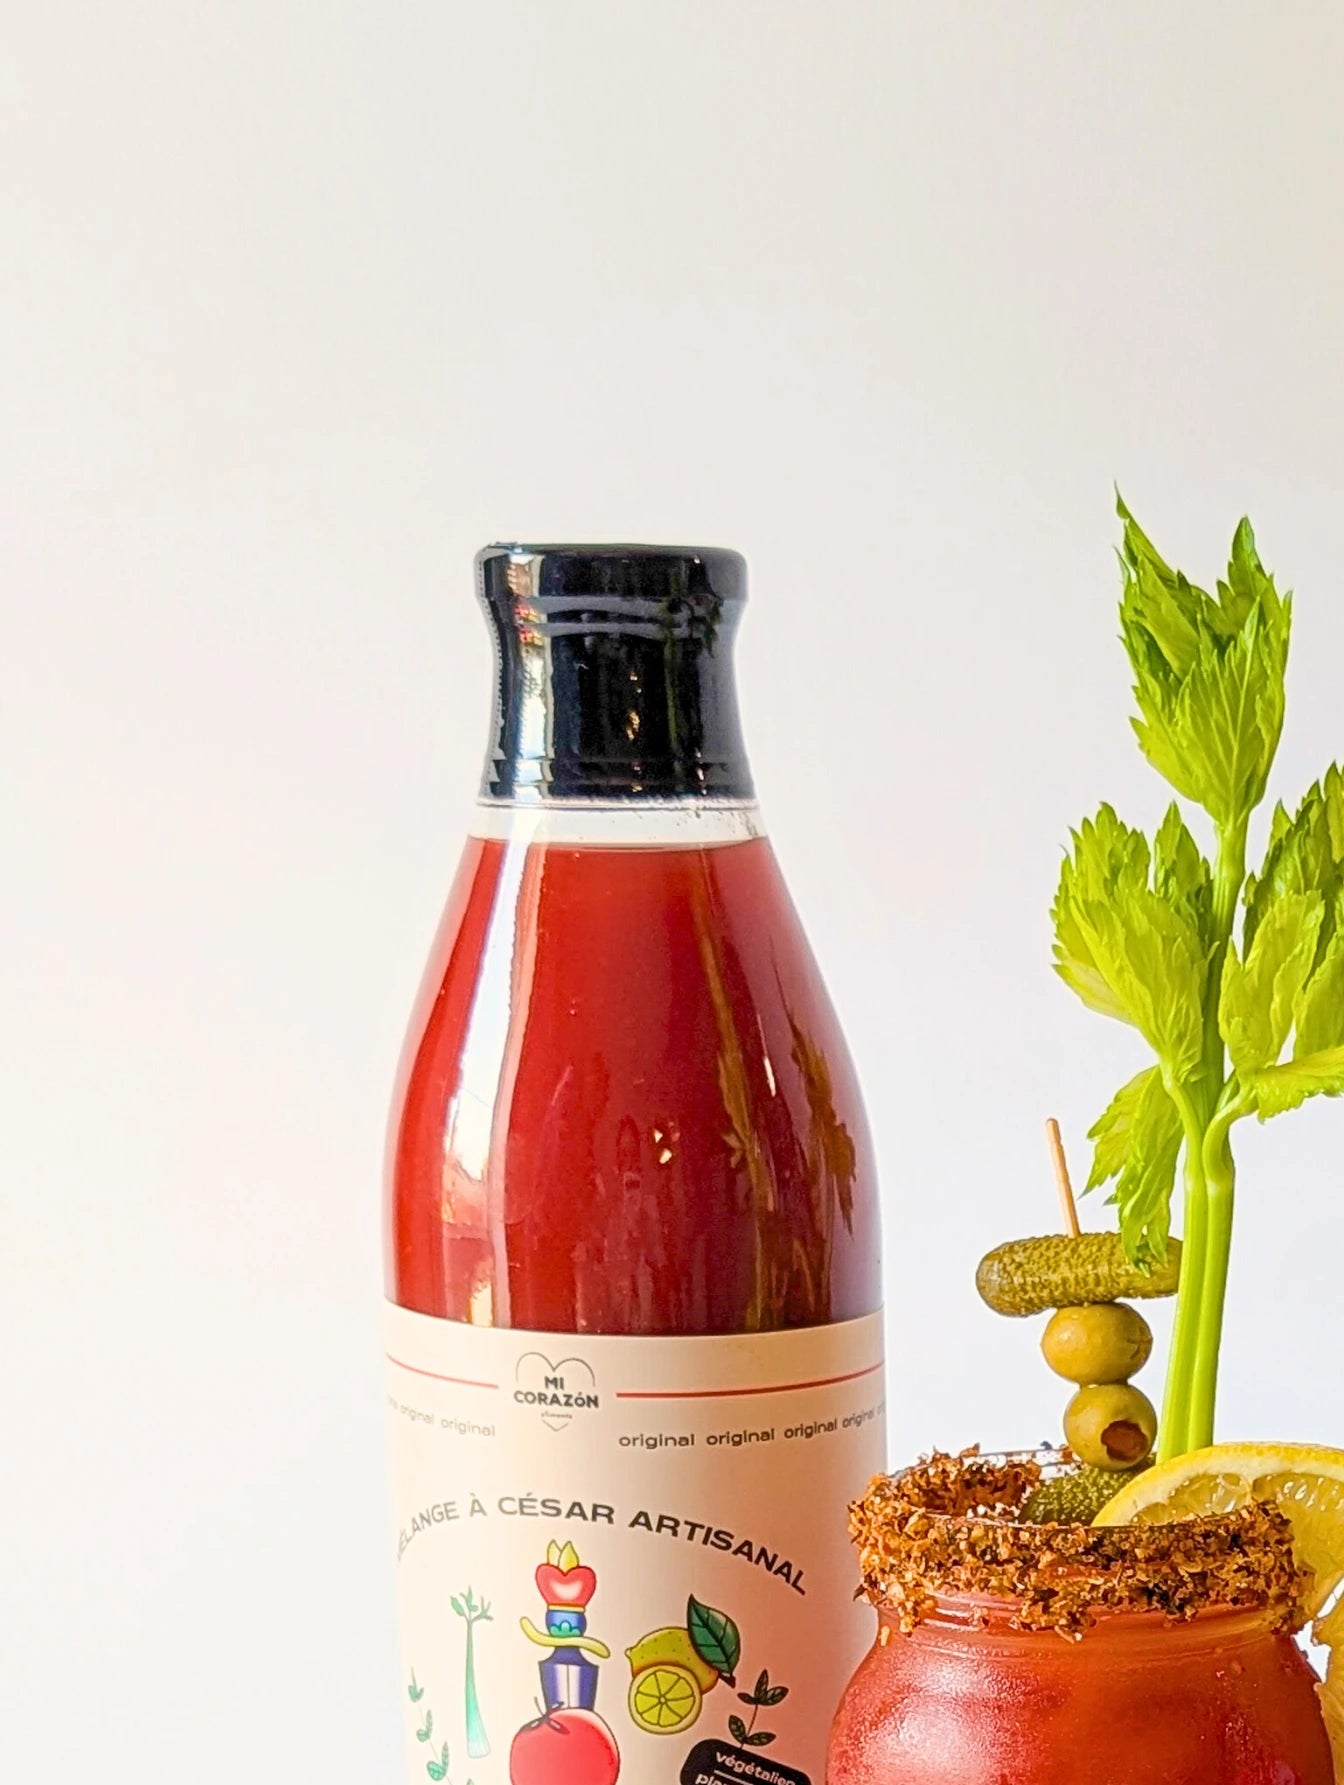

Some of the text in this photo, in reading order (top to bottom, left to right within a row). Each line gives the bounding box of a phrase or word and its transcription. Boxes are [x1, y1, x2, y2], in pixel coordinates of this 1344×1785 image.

[544, 1376, 564, 1390] MI
[440, 1418, 495, 1437] original
[619, 1418, 838, 1449] original original original
[468, 1492, 807, 1596] À CÉSAR ARTISANAL
